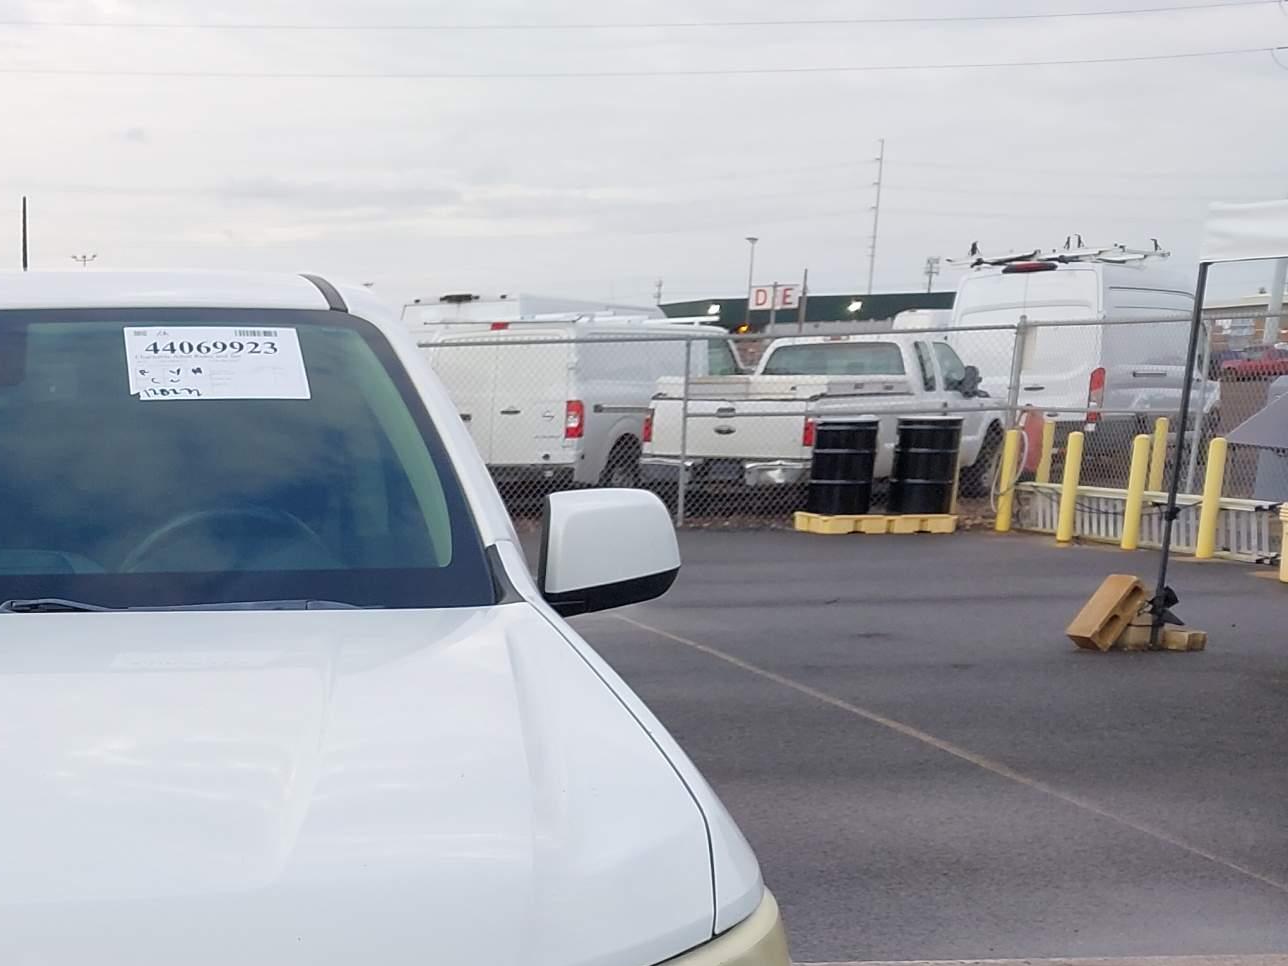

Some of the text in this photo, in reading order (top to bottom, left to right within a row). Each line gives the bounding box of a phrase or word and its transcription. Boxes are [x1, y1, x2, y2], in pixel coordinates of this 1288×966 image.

[755, 288, 794, 306] D E
[144, 341, 278, 354] 44069923
